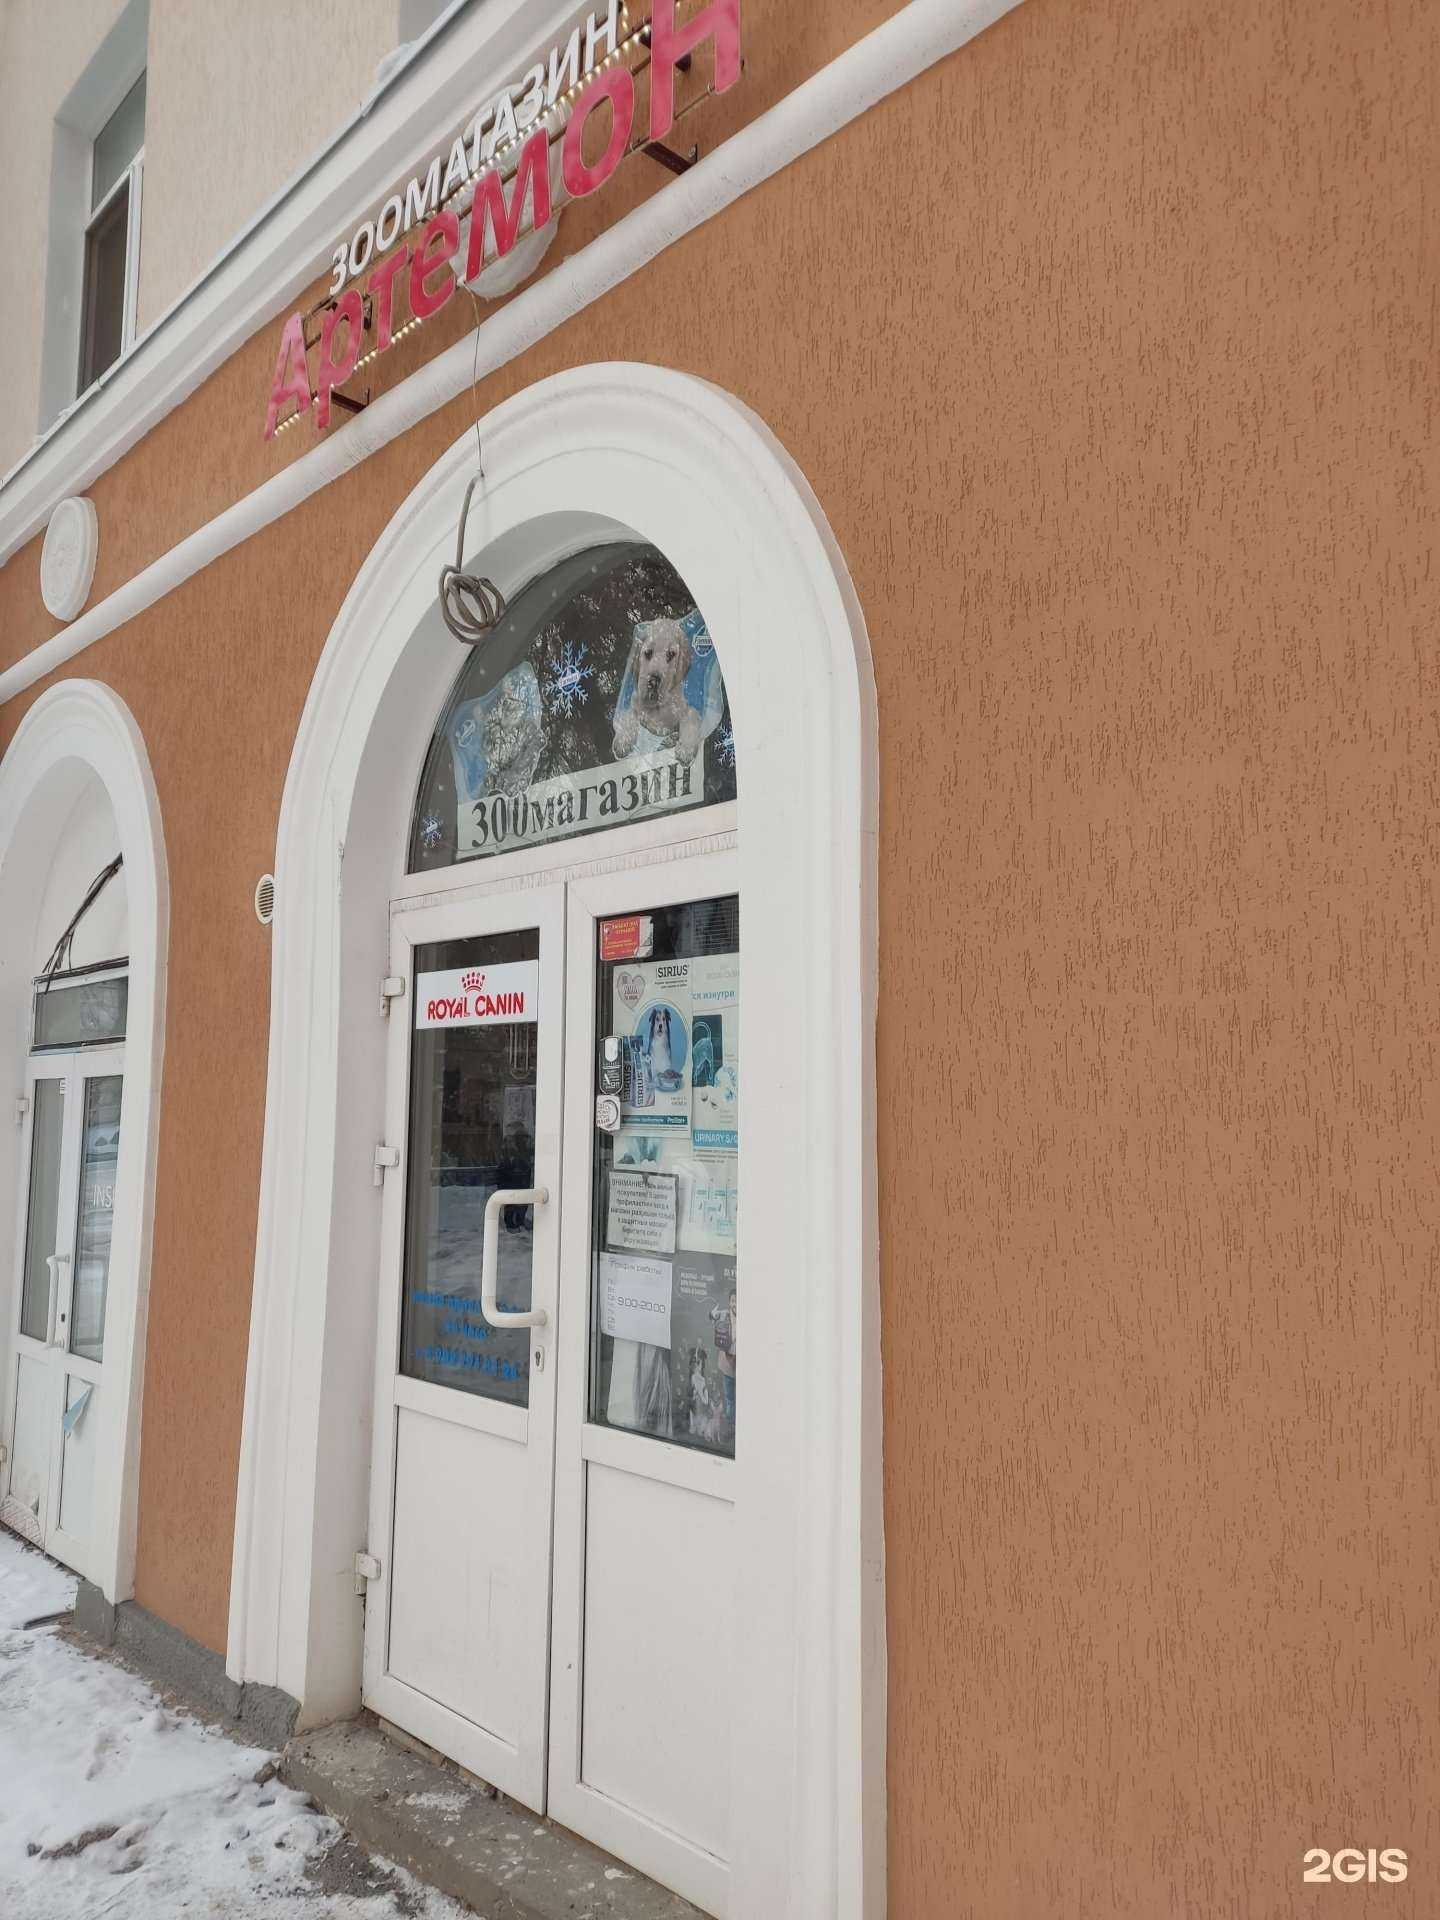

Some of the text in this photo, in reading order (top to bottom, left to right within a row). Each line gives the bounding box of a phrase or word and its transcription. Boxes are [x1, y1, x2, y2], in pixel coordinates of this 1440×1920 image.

[328, 1, 623, 298] ЗООМАГАЗИН
[657, 965, 688, 978] SIRIUS
[427, 992, 525, 1021] ROYAL CANIN
